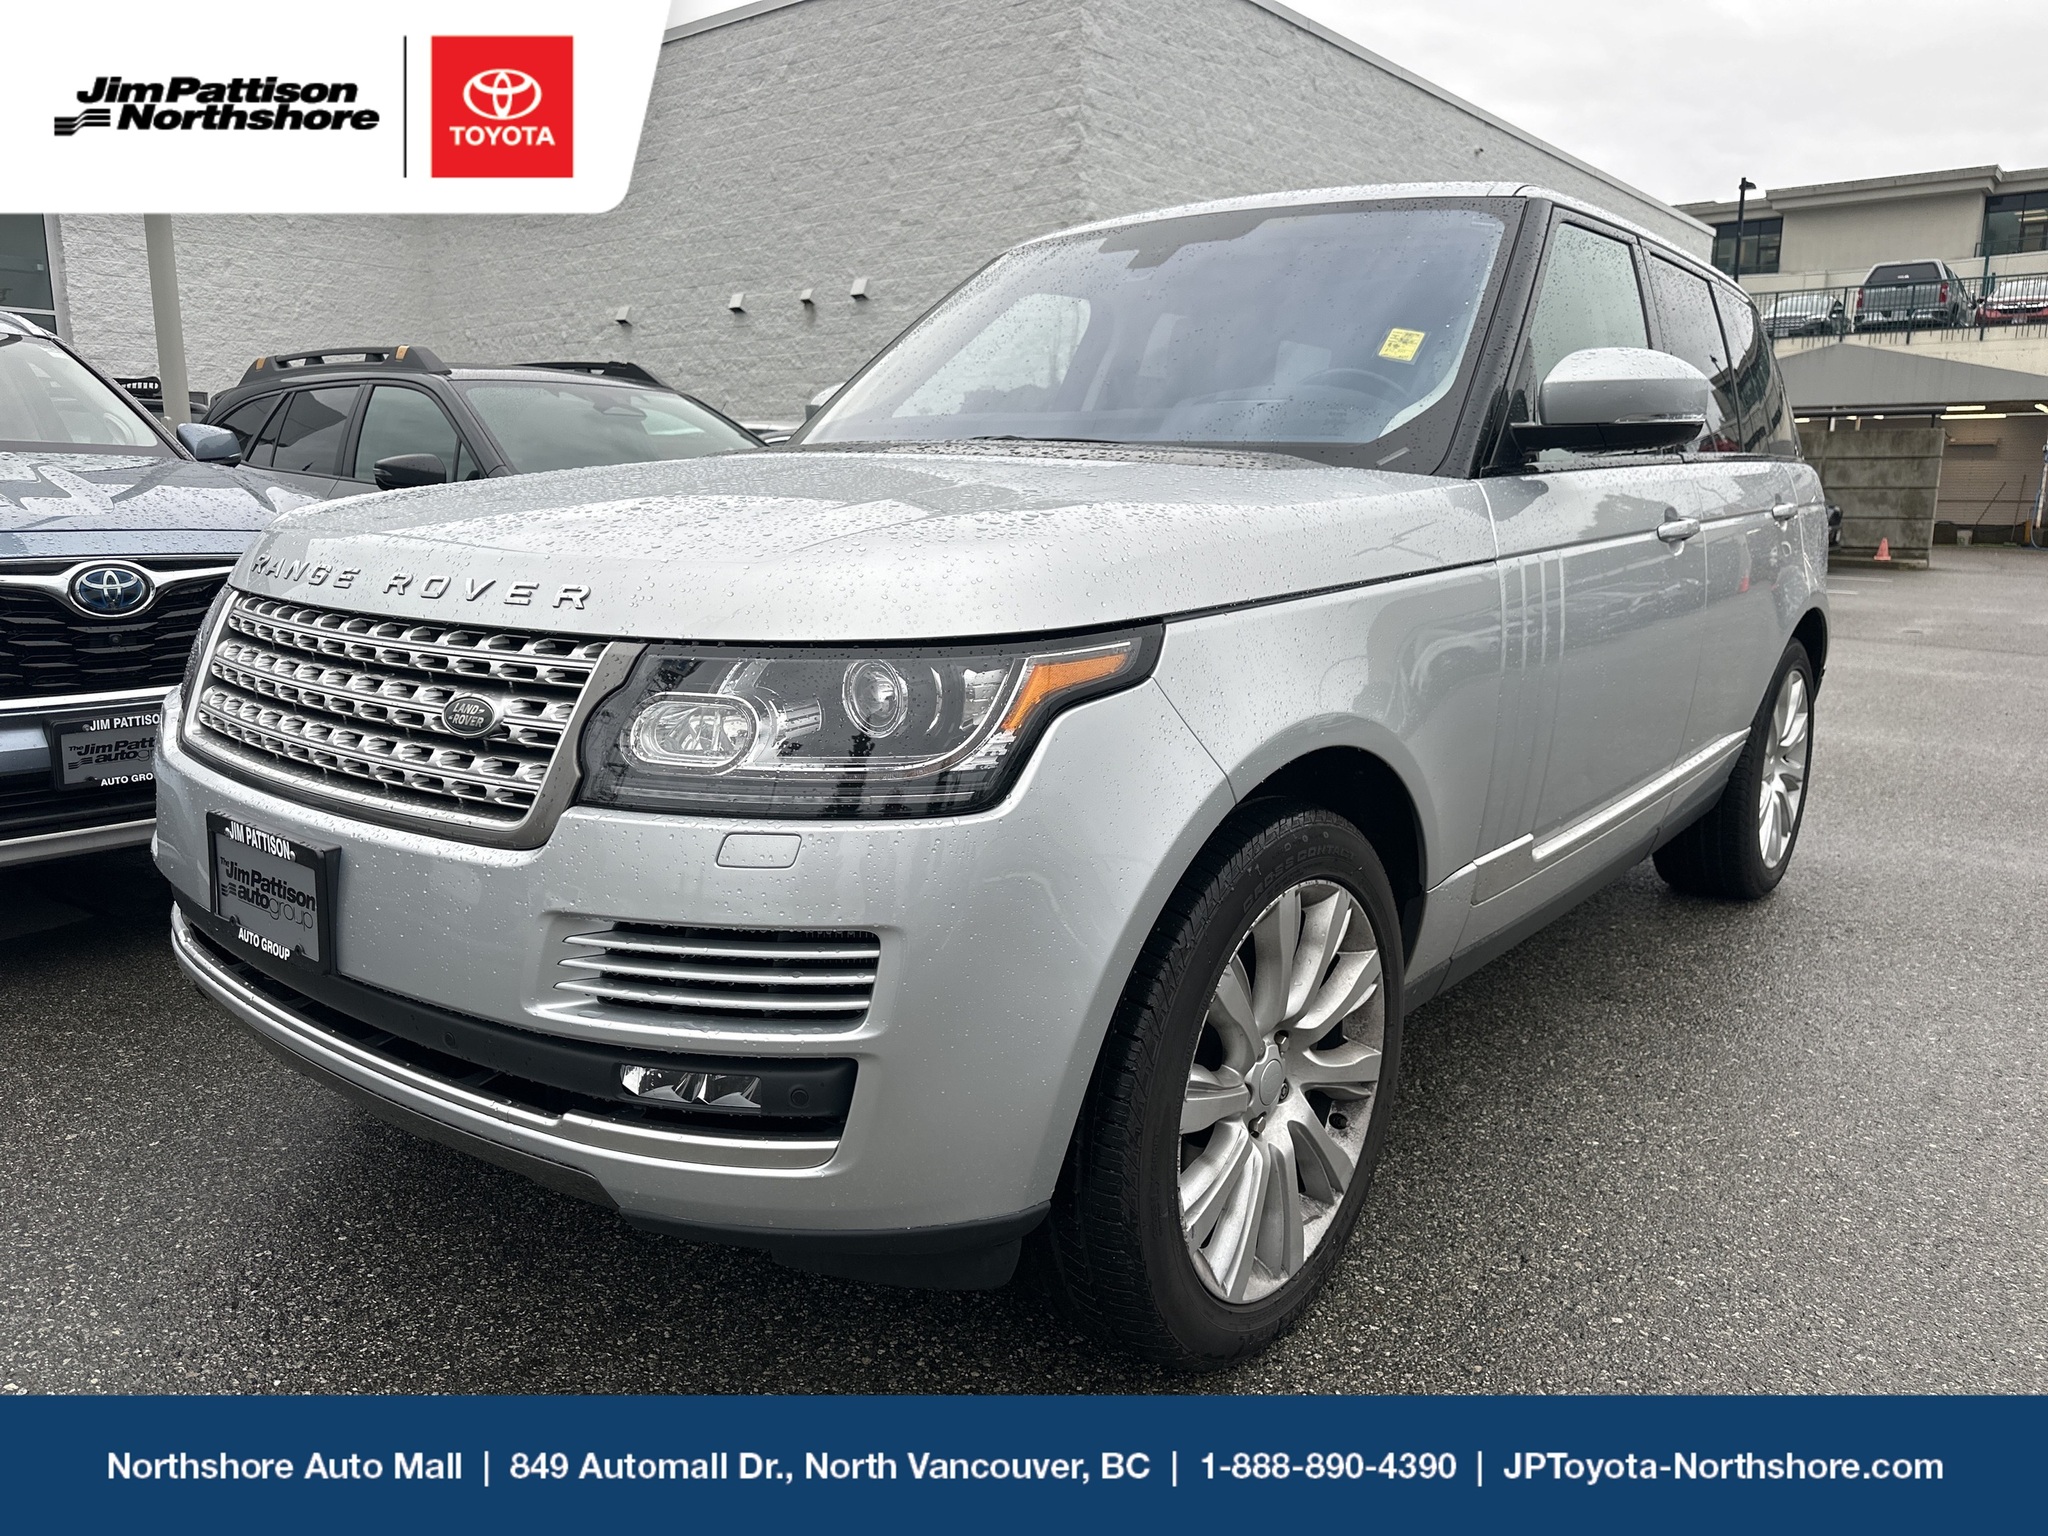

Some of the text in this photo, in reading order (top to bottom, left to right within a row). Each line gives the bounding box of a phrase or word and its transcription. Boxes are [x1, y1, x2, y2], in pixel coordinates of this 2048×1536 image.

[250, 553, 592, 610] RANGE ROVER
[453, 702, 480, 715] LAND
[90, 713, 161, 732] JIM PATTISO
[452, 713, 485, 728] ROVER
[100, 772, 154, 787] AUTO GRO
[228, 820, 291, 861] JIM PATTISON
[238, 927, 291, 961] AUTO GROUP
